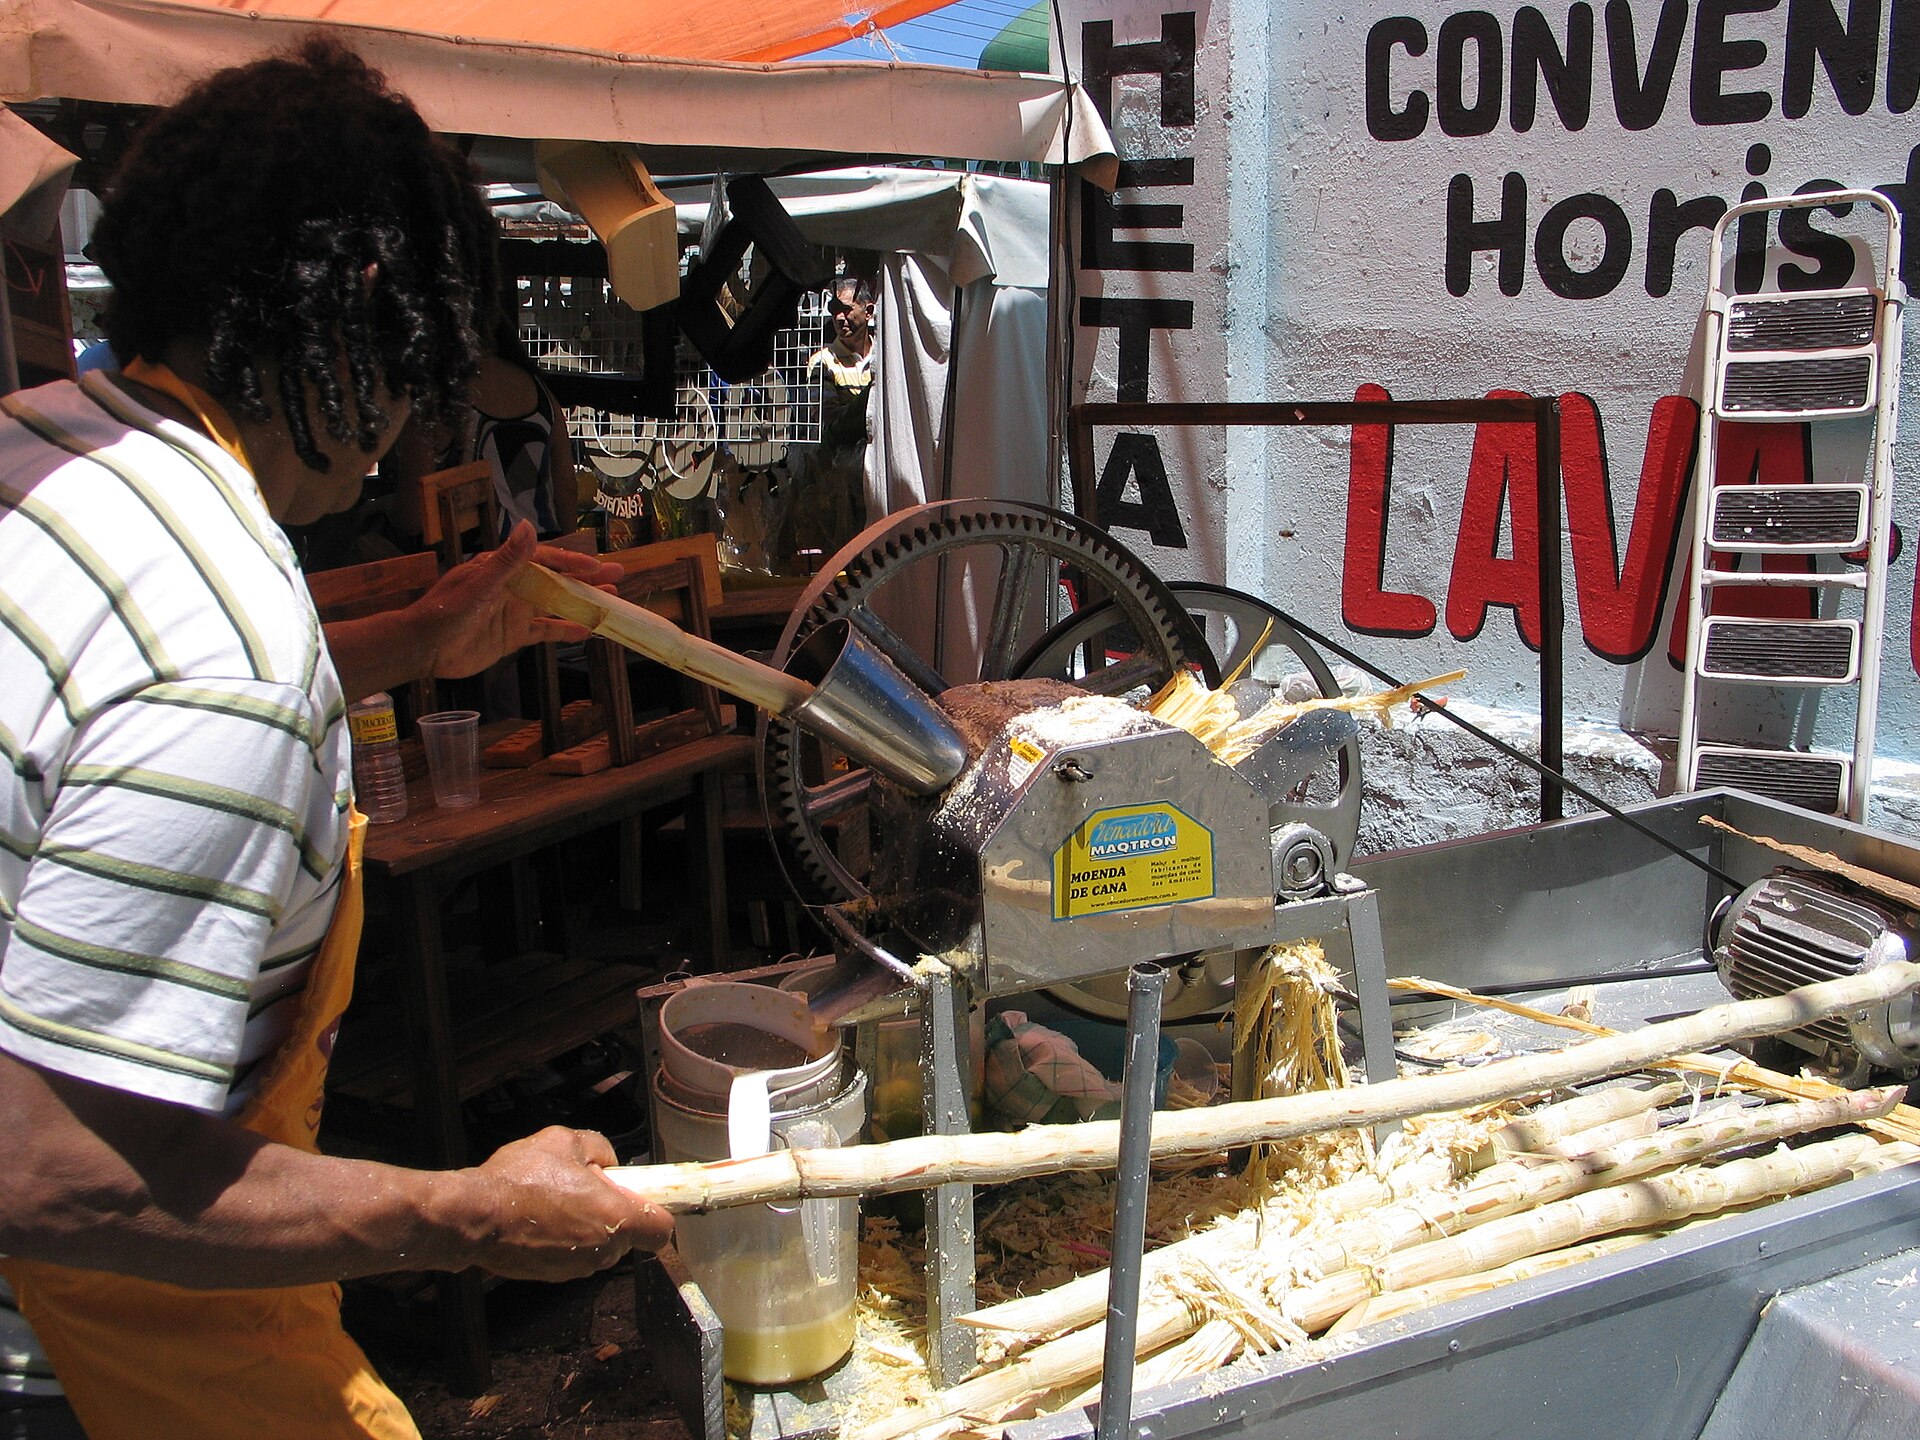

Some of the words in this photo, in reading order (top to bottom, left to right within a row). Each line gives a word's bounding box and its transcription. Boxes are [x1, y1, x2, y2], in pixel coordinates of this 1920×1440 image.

[1090, 835, 1177, 857] MAQTRON
[1071, 866, 1126, 884] MOENDA
[1151, 864, 1186, 873] fabricante
[1070, 886, 1088, 900] DE
[1091, 881, 1127, 896] CANA
